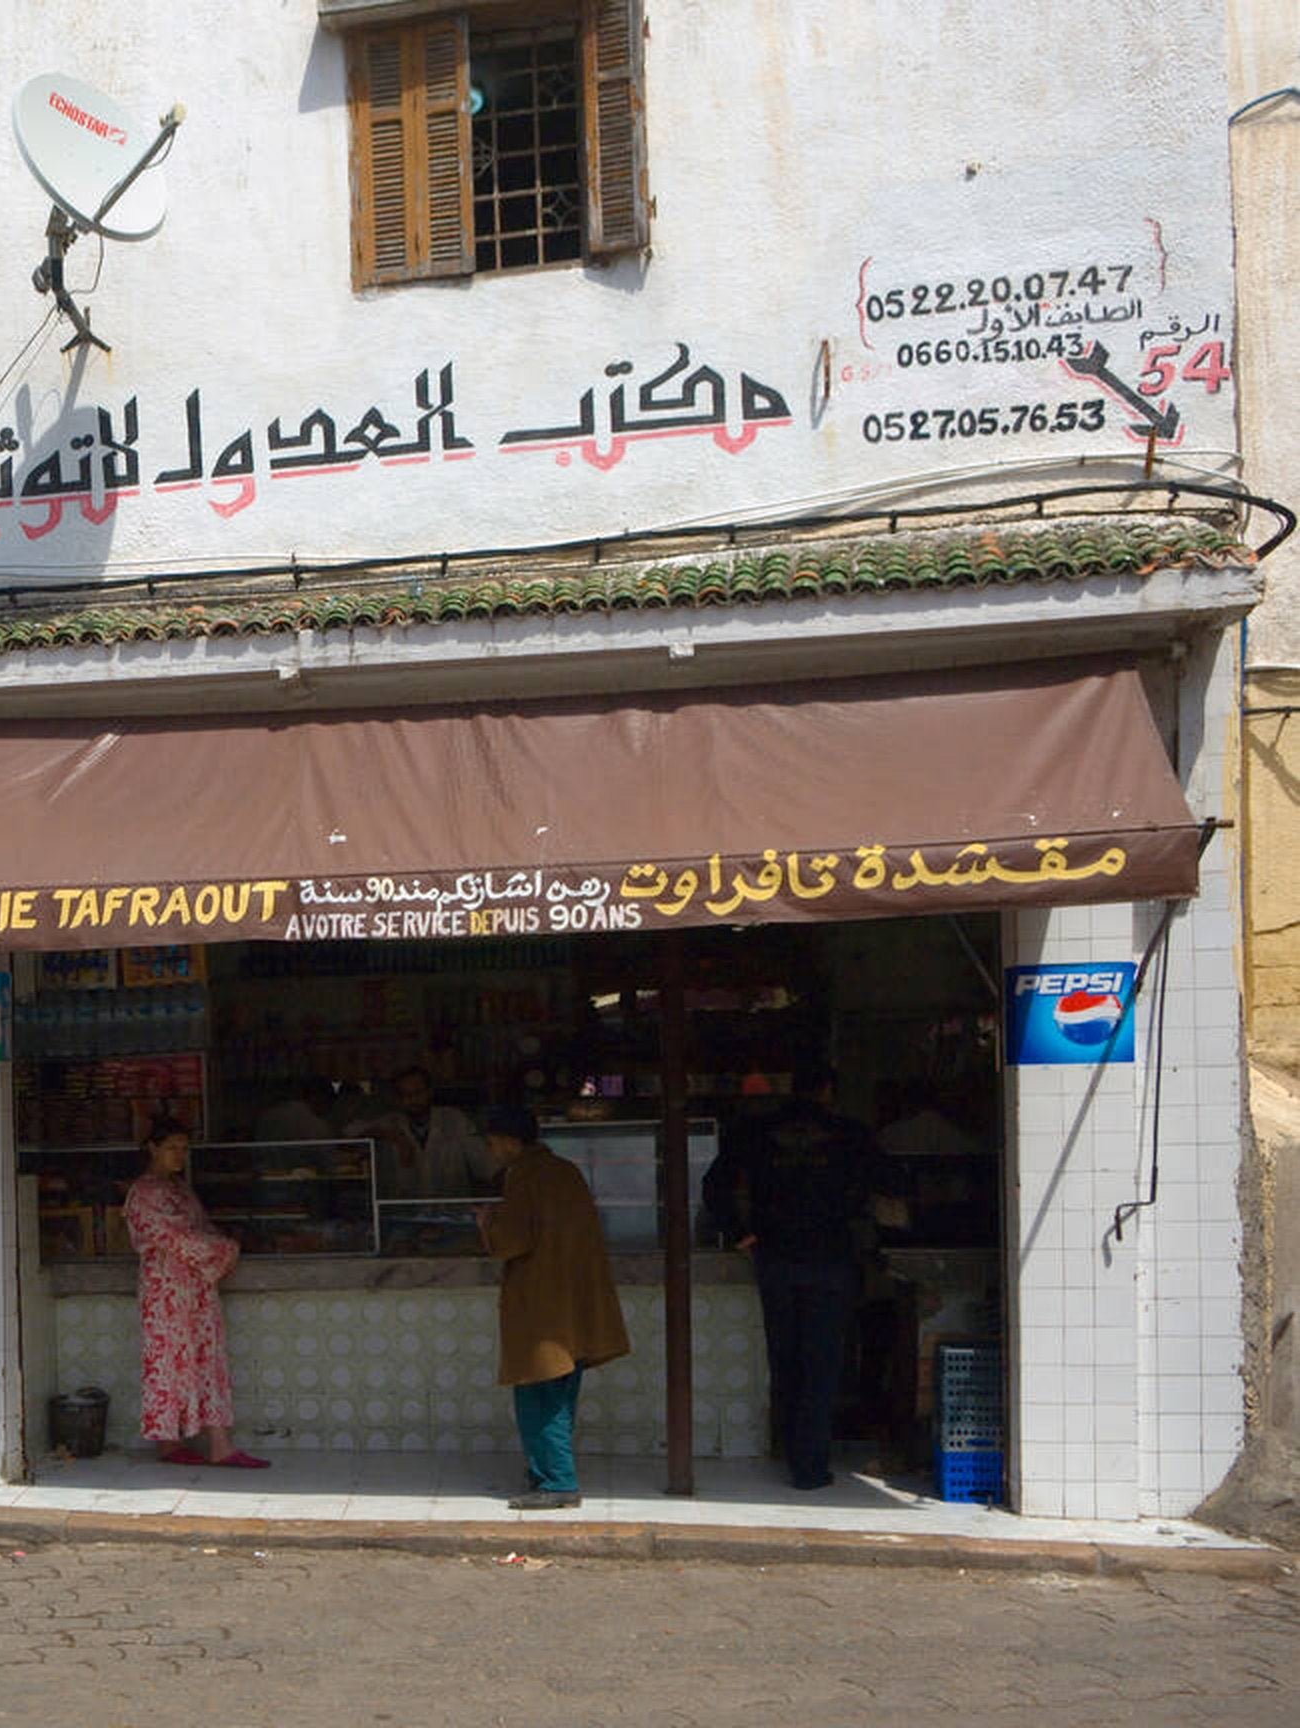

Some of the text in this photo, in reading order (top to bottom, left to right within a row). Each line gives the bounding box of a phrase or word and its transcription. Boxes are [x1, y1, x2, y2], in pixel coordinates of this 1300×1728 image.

[49, 91, 109, 138] ECHOSTAR
[865, 265, 1133, 322] 0522.20.07.47
[1140, 313, 1220, 350] الرقم
[1138, 341, 1231, 396] 54
[500, 342, 793, 471] مكتب
[52, 880, 289, 929] TAFRAOUT
[546, 877, 611, 907] رهن
[620, 849, 841, 915] تافراوت
[371, 909, 468, 939] SERVICE
[470, 907, 540, 936] DEPUIS
[549, 904, 588, 930] 90
[589, 902, 642, 930] ANS
[1015, 971, 1124, 996] PEPSI
